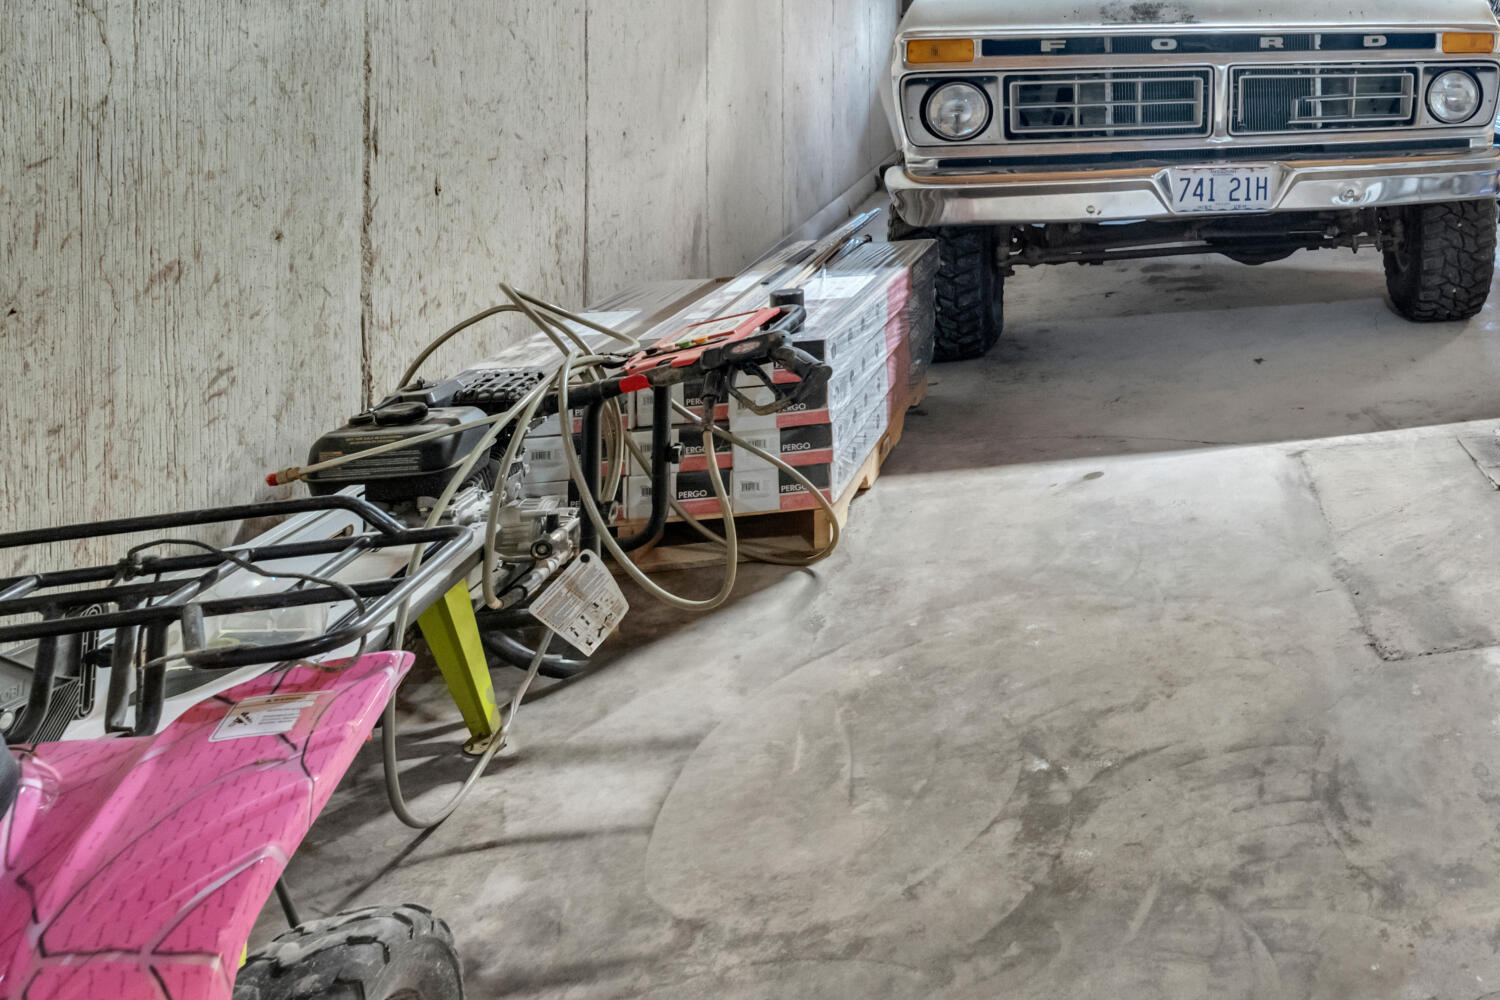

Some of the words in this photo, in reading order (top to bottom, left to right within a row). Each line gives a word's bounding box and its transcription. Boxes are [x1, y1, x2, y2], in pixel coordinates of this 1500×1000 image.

[1040, 34, 1388, 52] FORD
[1179, 177, 1215, 203] 741
[1229, 176, 1268, 203] 21H
[782, 441, 811, 452] PERGO
[678, 489, 708, 499] PERGO
